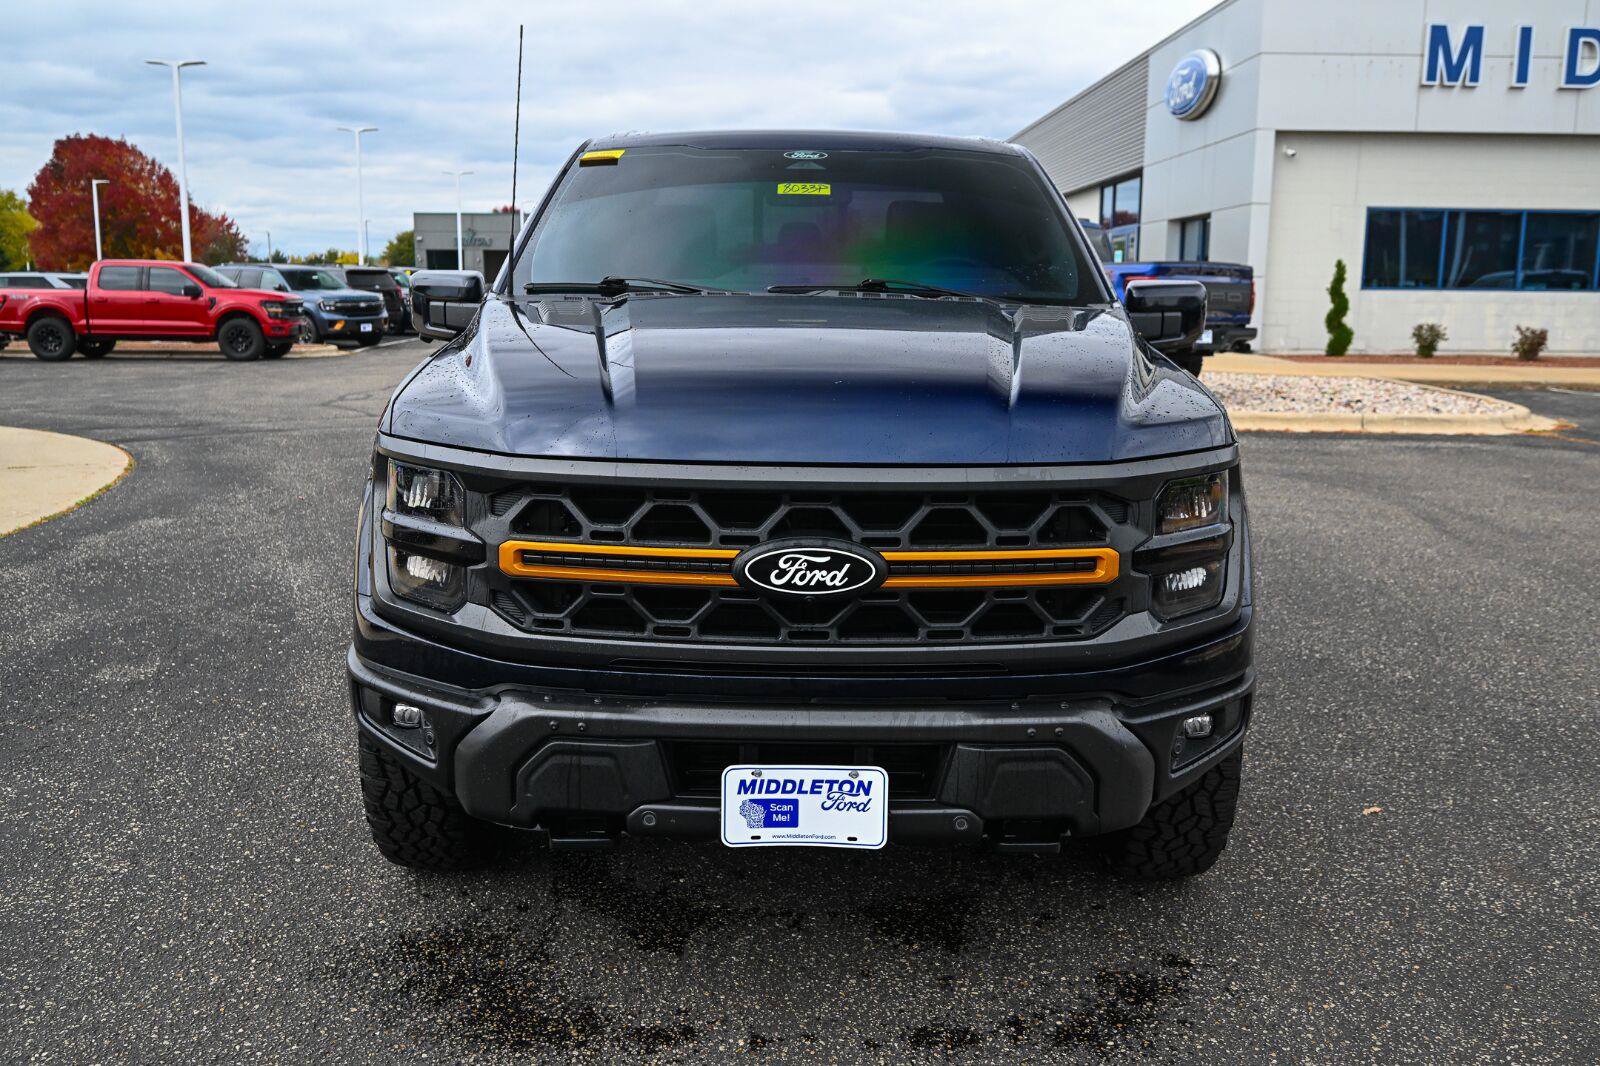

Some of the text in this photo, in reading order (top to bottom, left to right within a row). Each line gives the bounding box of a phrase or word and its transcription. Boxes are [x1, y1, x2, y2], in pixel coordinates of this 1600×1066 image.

[1424, 24, 1600, 87] MID
[790, 151, 820, 159] Ford
[770, 554, 850, 587] Ford
[737, 779, 873, 796] MIDDLETON
[769, 804, 794, 812] Scan
[821, 791, 872, 812] Ford
